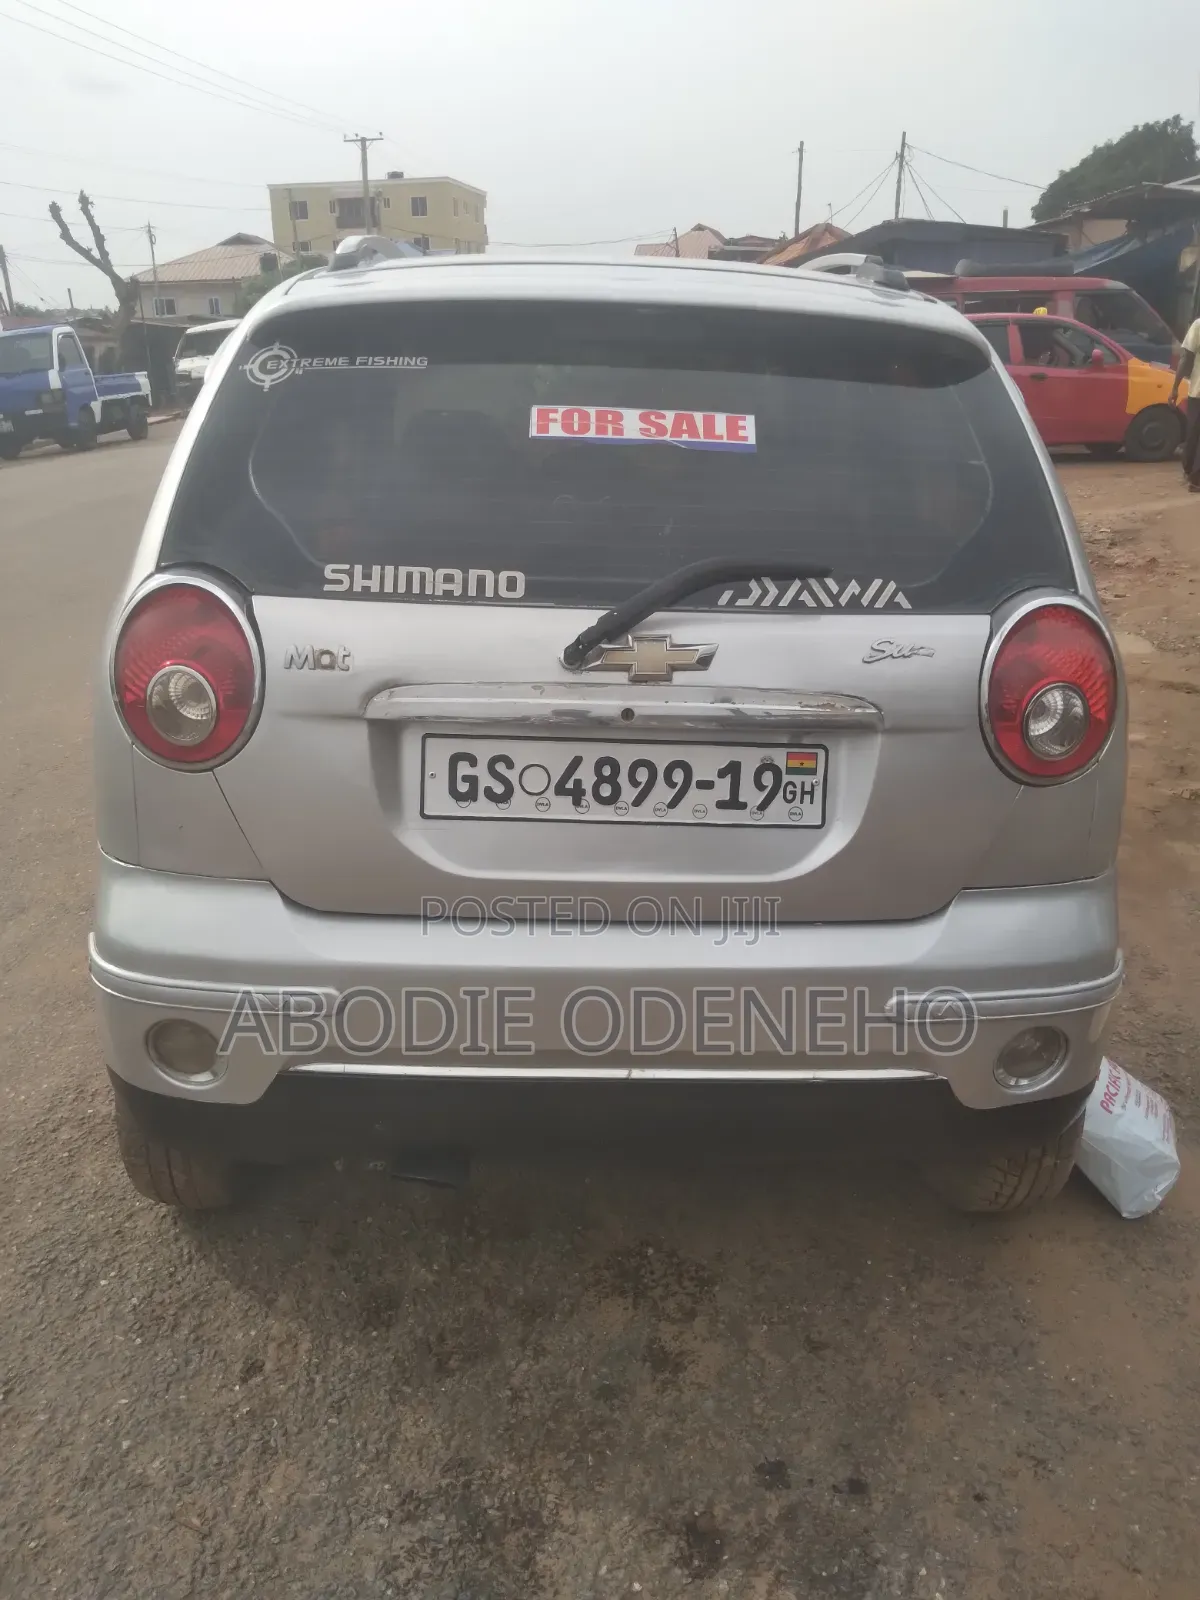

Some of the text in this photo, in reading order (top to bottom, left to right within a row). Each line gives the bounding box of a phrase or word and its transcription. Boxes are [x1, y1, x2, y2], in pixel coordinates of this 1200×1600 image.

[266, 356, 428, 370] EXTREME FISHING
[536, 407, 749, 442] FOR SALE
[322, 563, 526, 599] SHIMANO
[447, 751, 784, 812] GS 4899-19
[783, 780, 815, 805] GH
